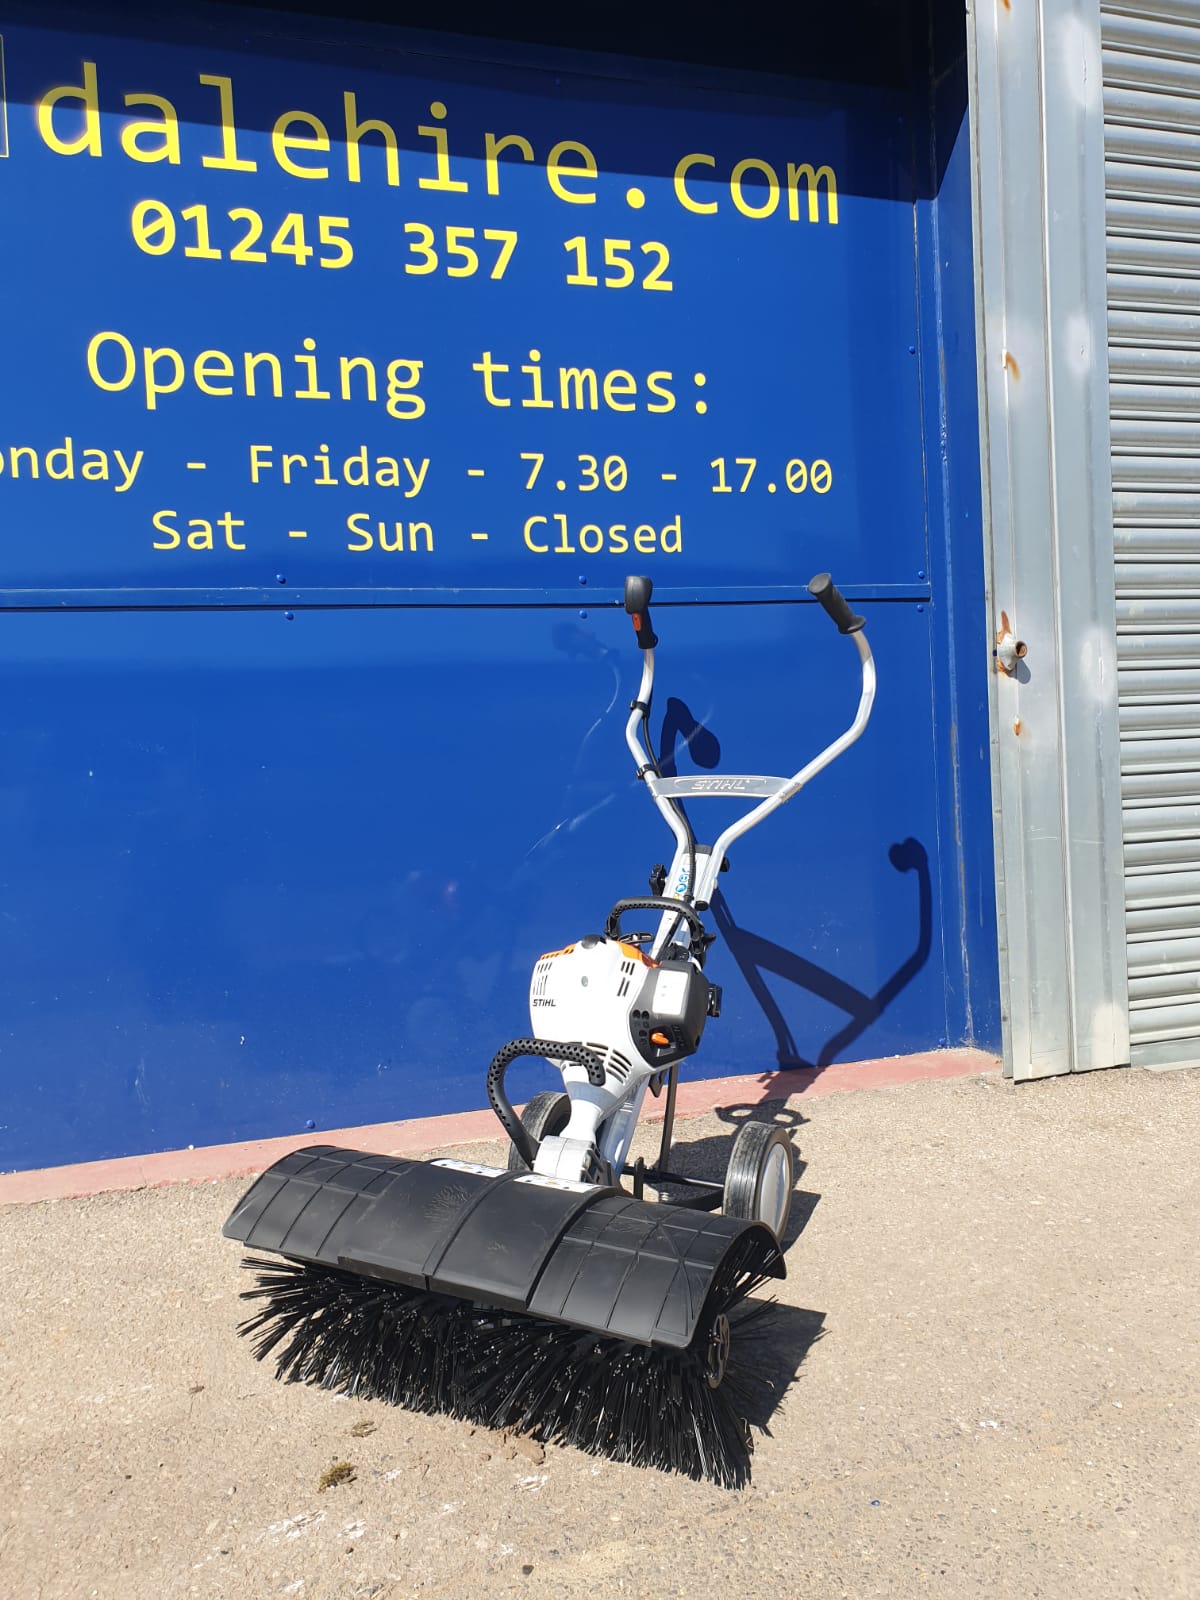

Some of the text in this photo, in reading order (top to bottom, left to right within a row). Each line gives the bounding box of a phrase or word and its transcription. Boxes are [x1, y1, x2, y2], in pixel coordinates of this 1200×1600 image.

[36, 61, 840, 226] dalehire.com
[131, 199, 674, 292] 01245 357 152
[87, 331, 708, 420] Opening times:
[0, 436, 144, 492] nday
[250, 444, 431, 498] Friday
[520, 452, 629, 492] 7.30
[710, 457, 833, 494] 17.00
[152, 510, 247, 551] Sat
[347, 513, 435, 553] Sun
[523, 513, 683, 554] Closed
[691, 779, 746, 790] STIHL
[532, 998, 557, 1007] STIHL
